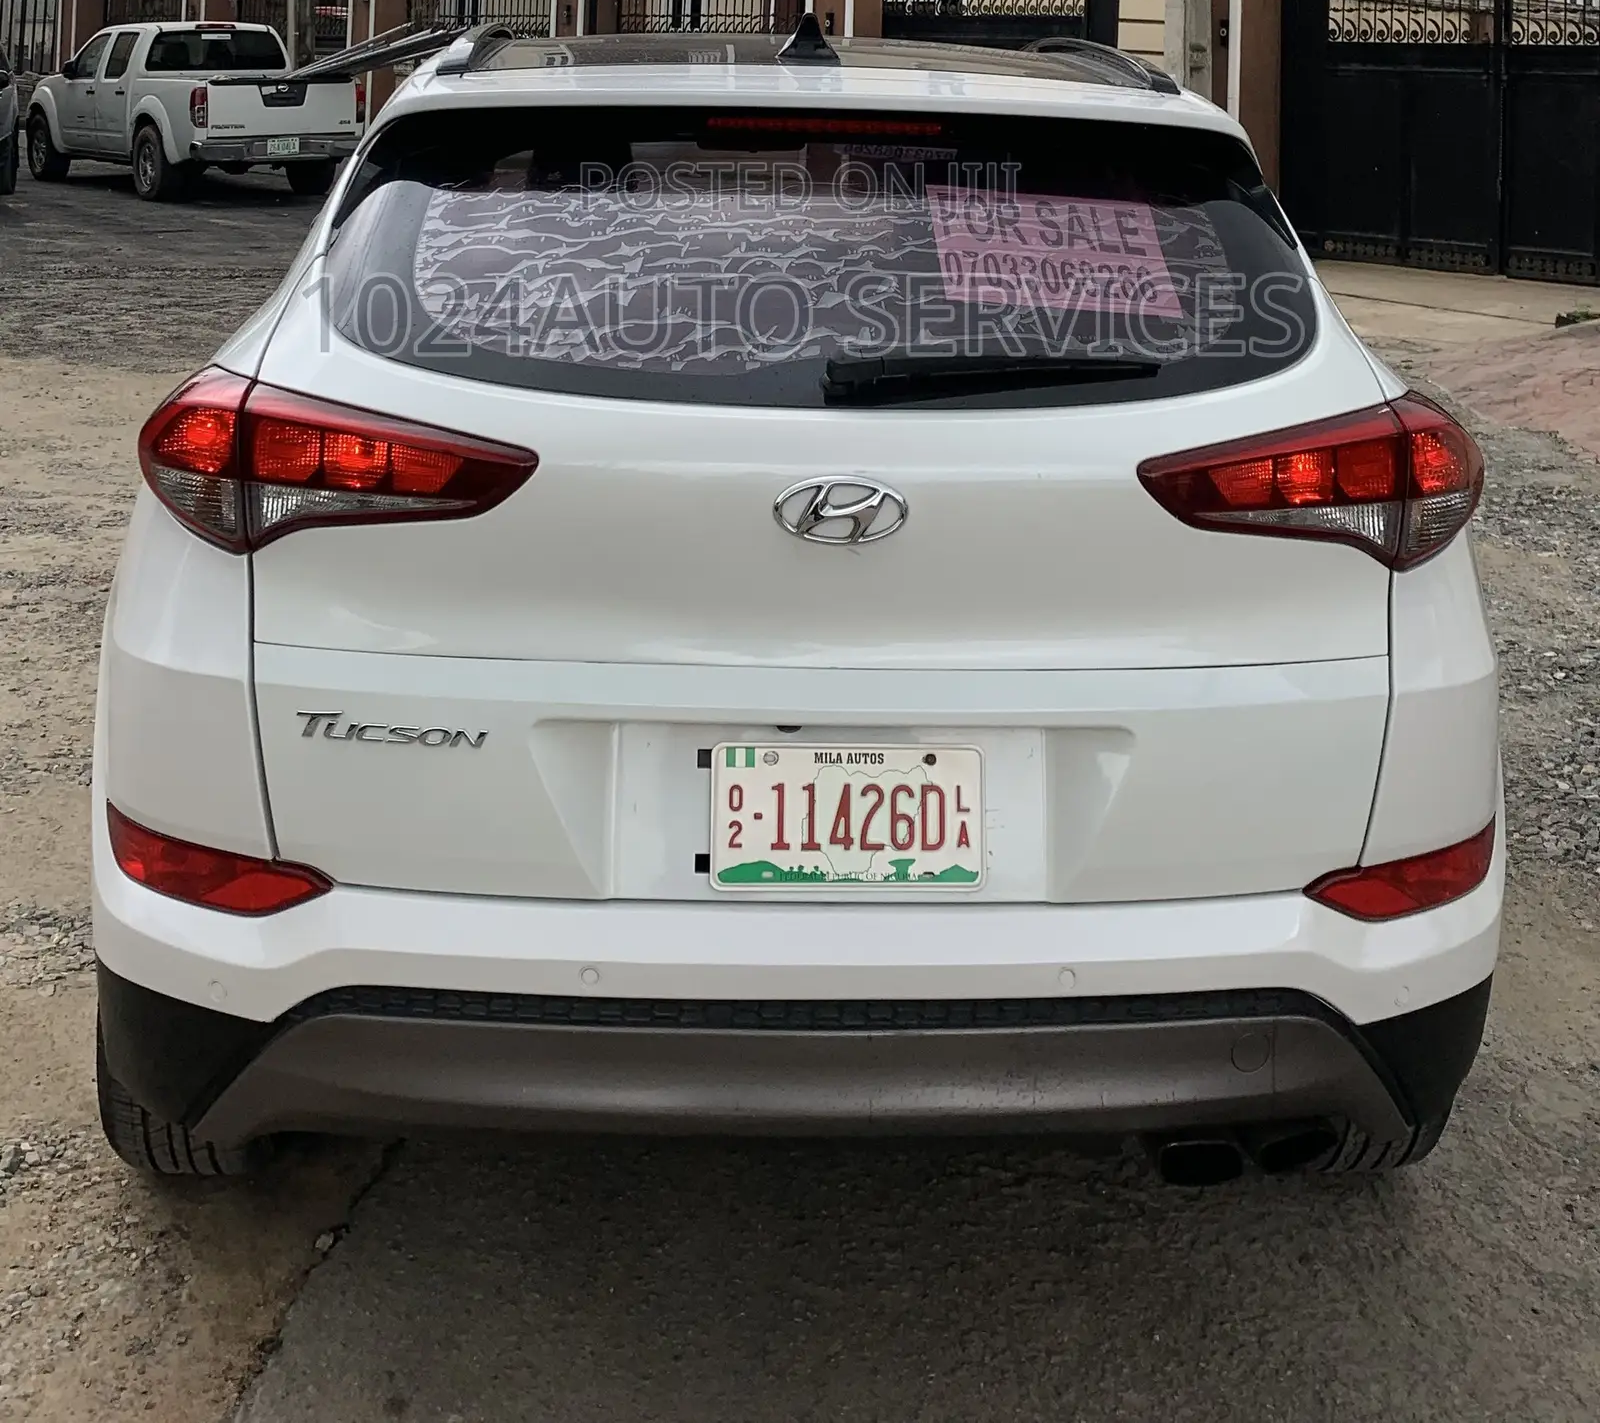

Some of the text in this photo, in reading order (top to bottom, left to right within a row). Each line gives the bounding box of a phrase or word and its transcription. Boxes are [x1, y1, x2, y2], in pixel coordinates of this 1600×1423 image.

[936, 191, 1148, 257] FOR SALE
[814, 752, 885, 765] MILA AUTOS
